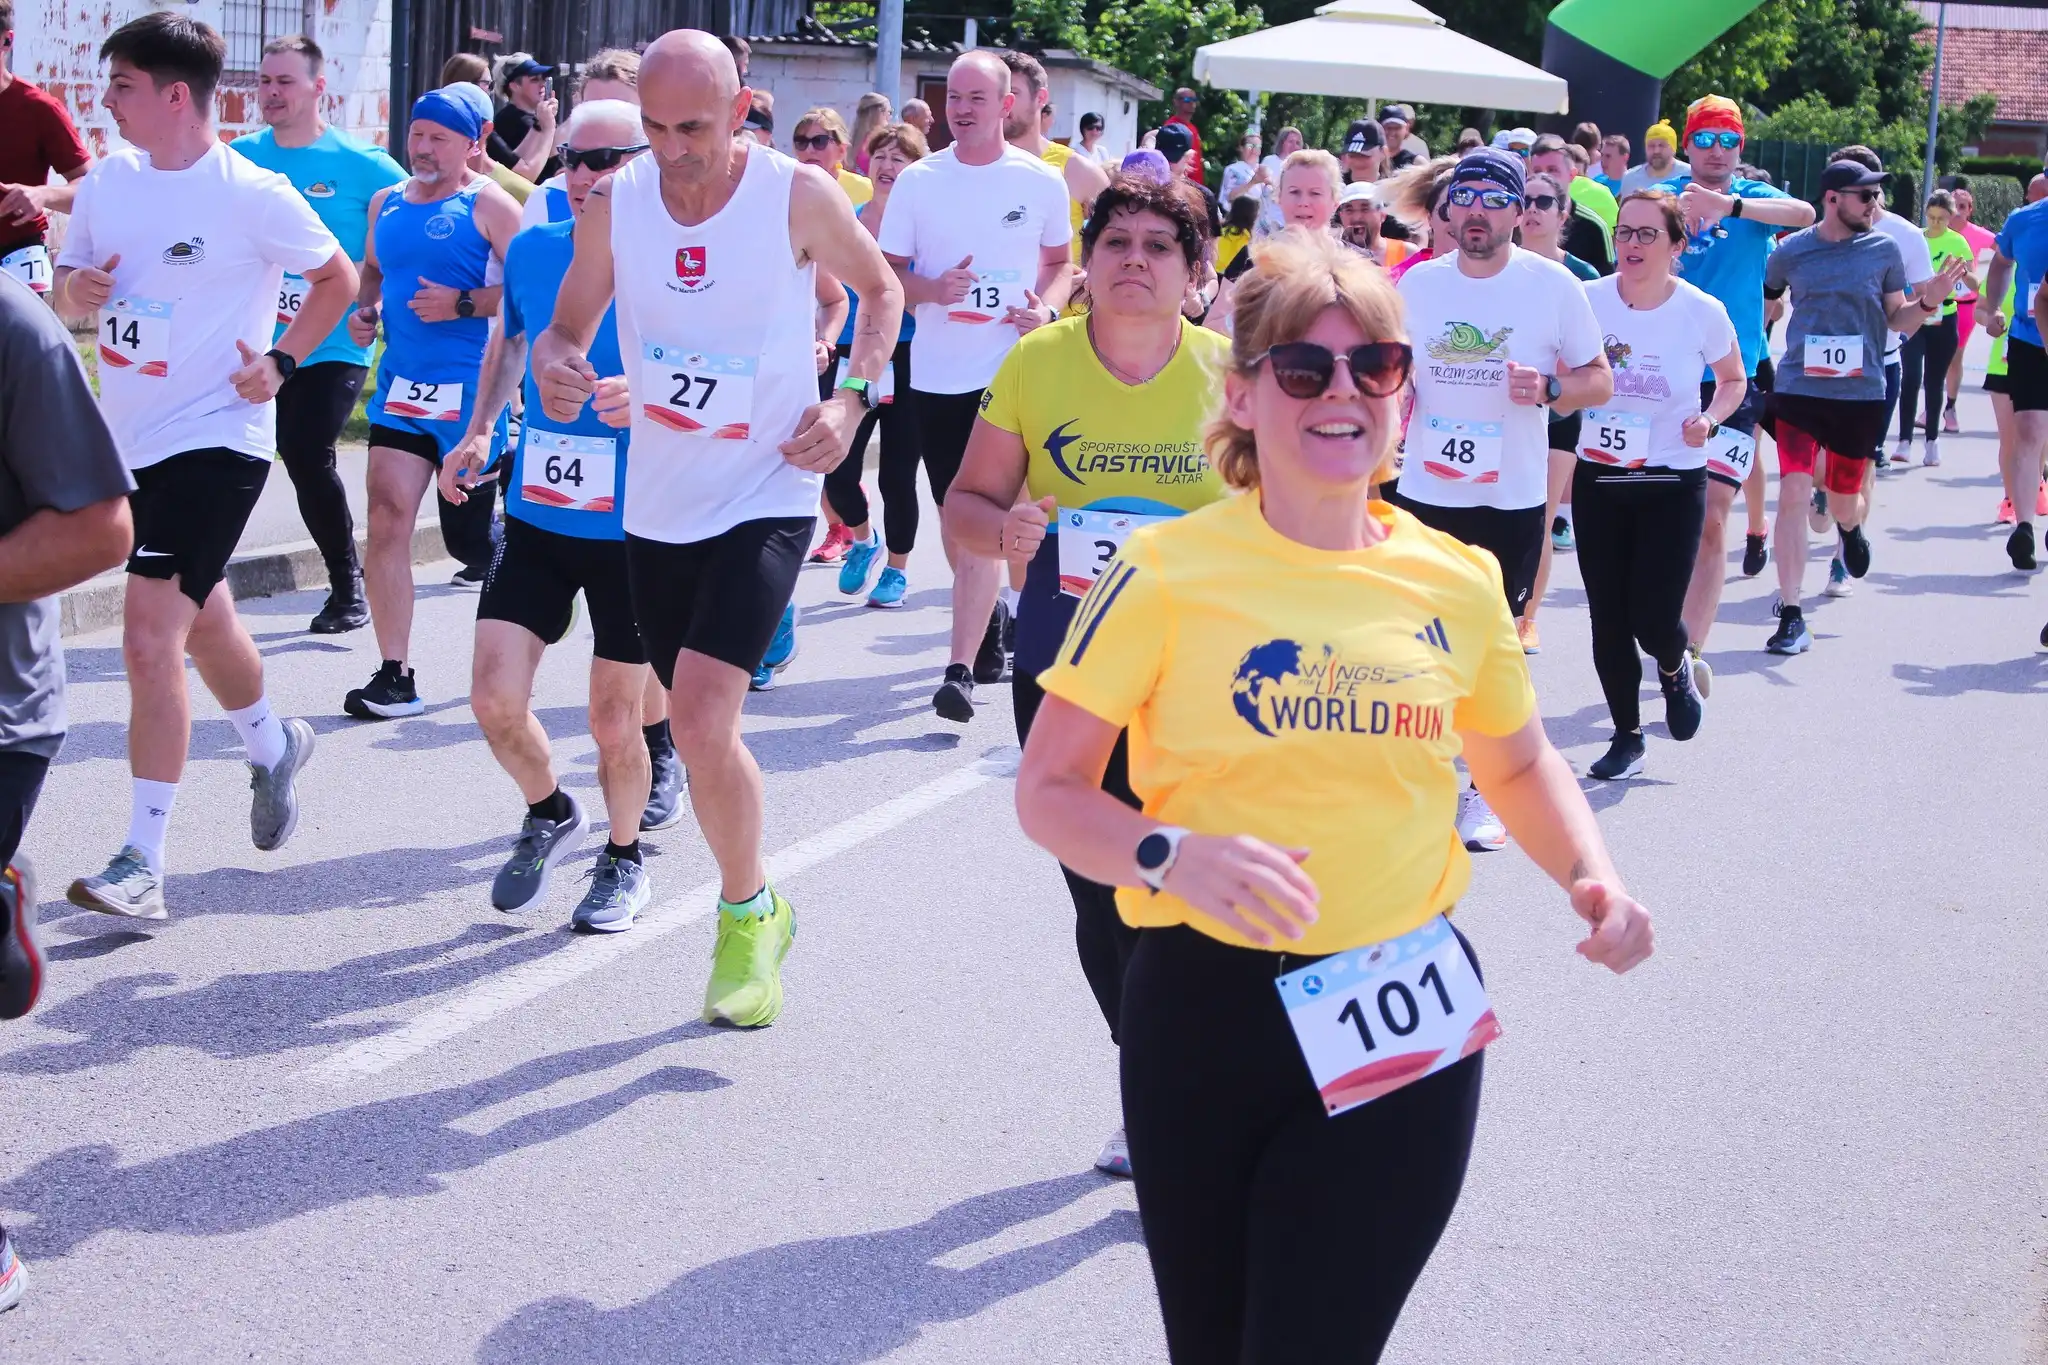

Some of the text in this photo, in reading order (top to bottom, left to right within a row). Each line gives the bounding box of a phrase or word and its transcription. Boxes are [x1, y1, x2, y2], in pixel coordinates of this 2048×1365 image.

[20, 260, 44, 279] 77
[971, 286, 1000, 308] 13
[106, 316, 141, 350] 14
[1823, 348, 1846, 365] 10
[407, 382, 439, 403] 52
[669, 372, 718, 410] 27
[1078, 441, 1203, 454] SPORTSKO DRUŠT
[1599, 426, 1627, 450] 55
[1441, 437, 1476, 464] 48
[1725, 445, 1749, 468] 44
[545, 455, 584, 487] 64
[1155, 473, 1204, 485] ZLATAR
[1301, 660, 1386, 683] WINGS
[1315, 682, 1362, 697] LIFE
[1270, 696, 1444, 741] WORLD RUN
[1337, 961, 1456, 1053] 101
